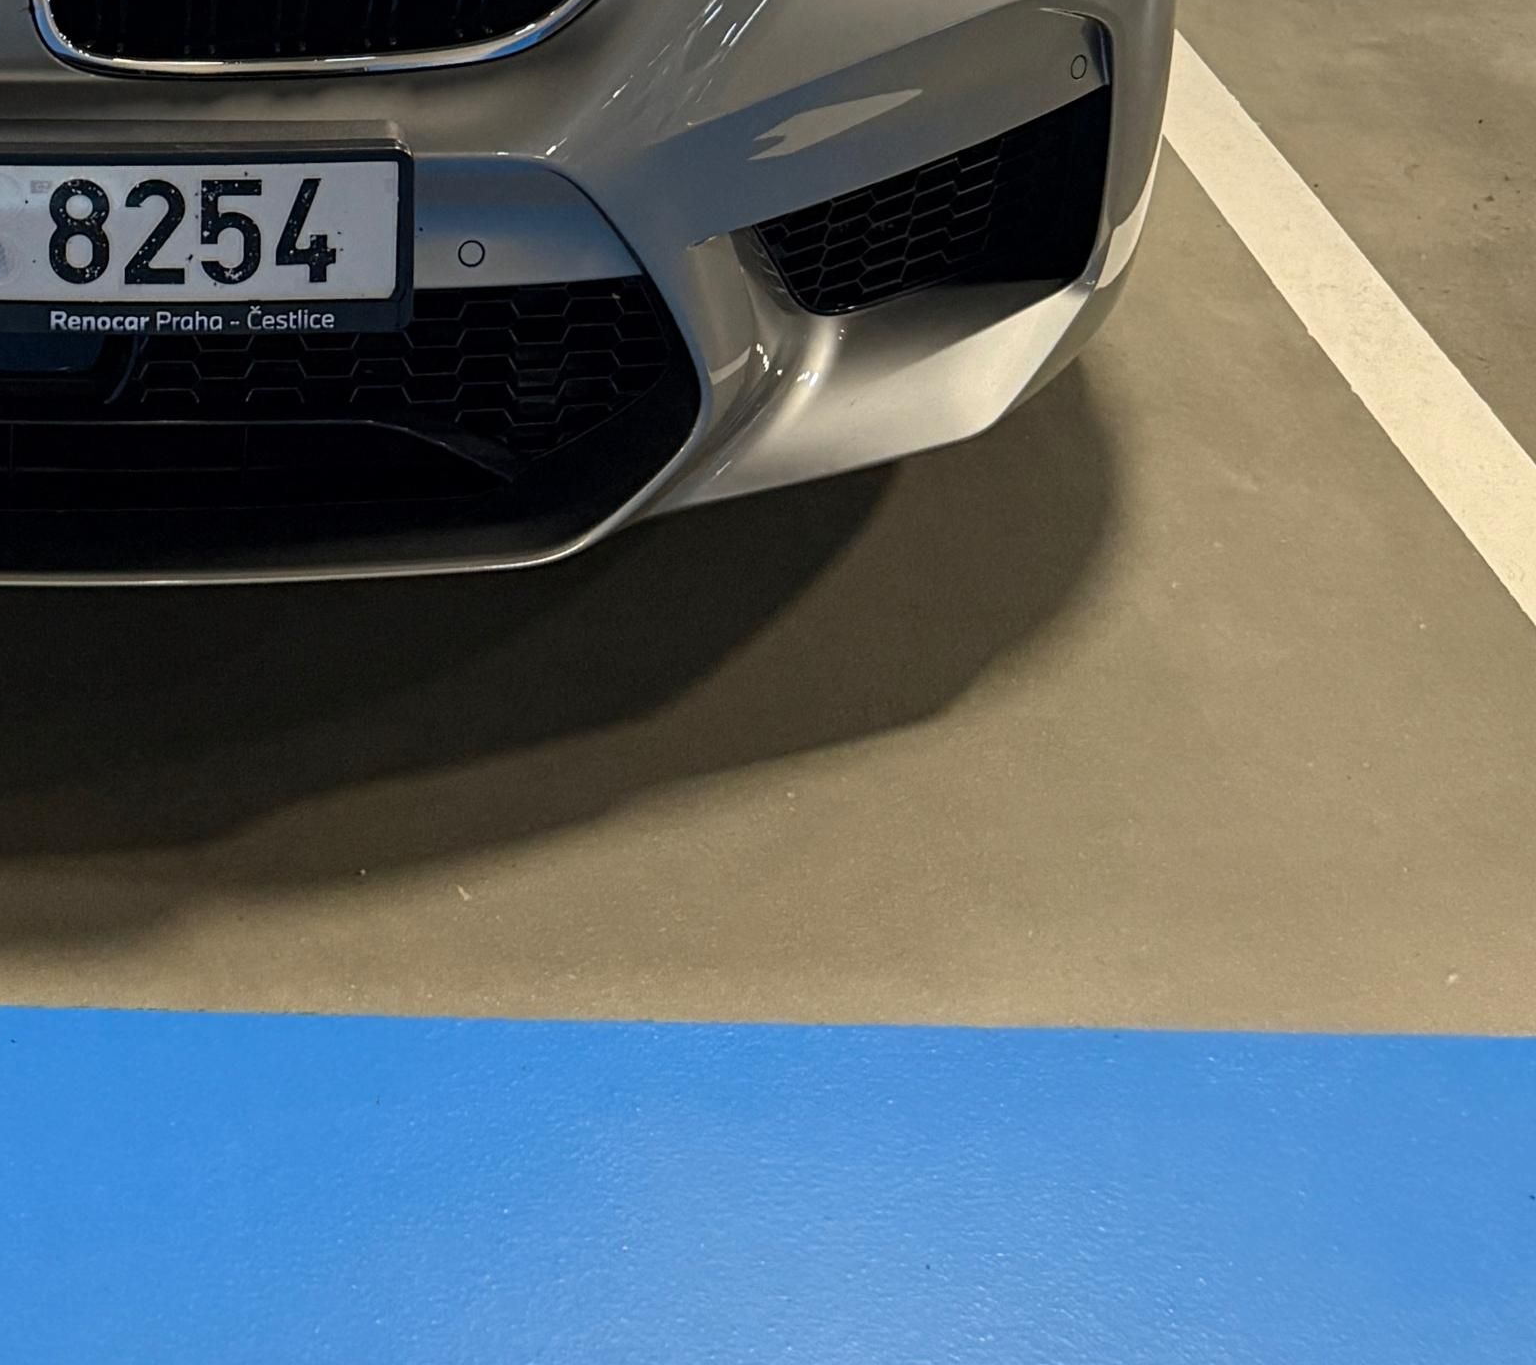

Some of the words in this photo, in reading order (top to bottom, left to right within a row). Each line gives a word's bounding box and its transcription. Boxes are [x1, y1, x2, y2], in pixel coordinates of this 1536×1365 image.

[48, 177, 337, 286] 8254
[49, 310, 150, 333] Renocar
[156, 311, 222, 332] Praha
[246, 305, 335, 331] Čestlice
